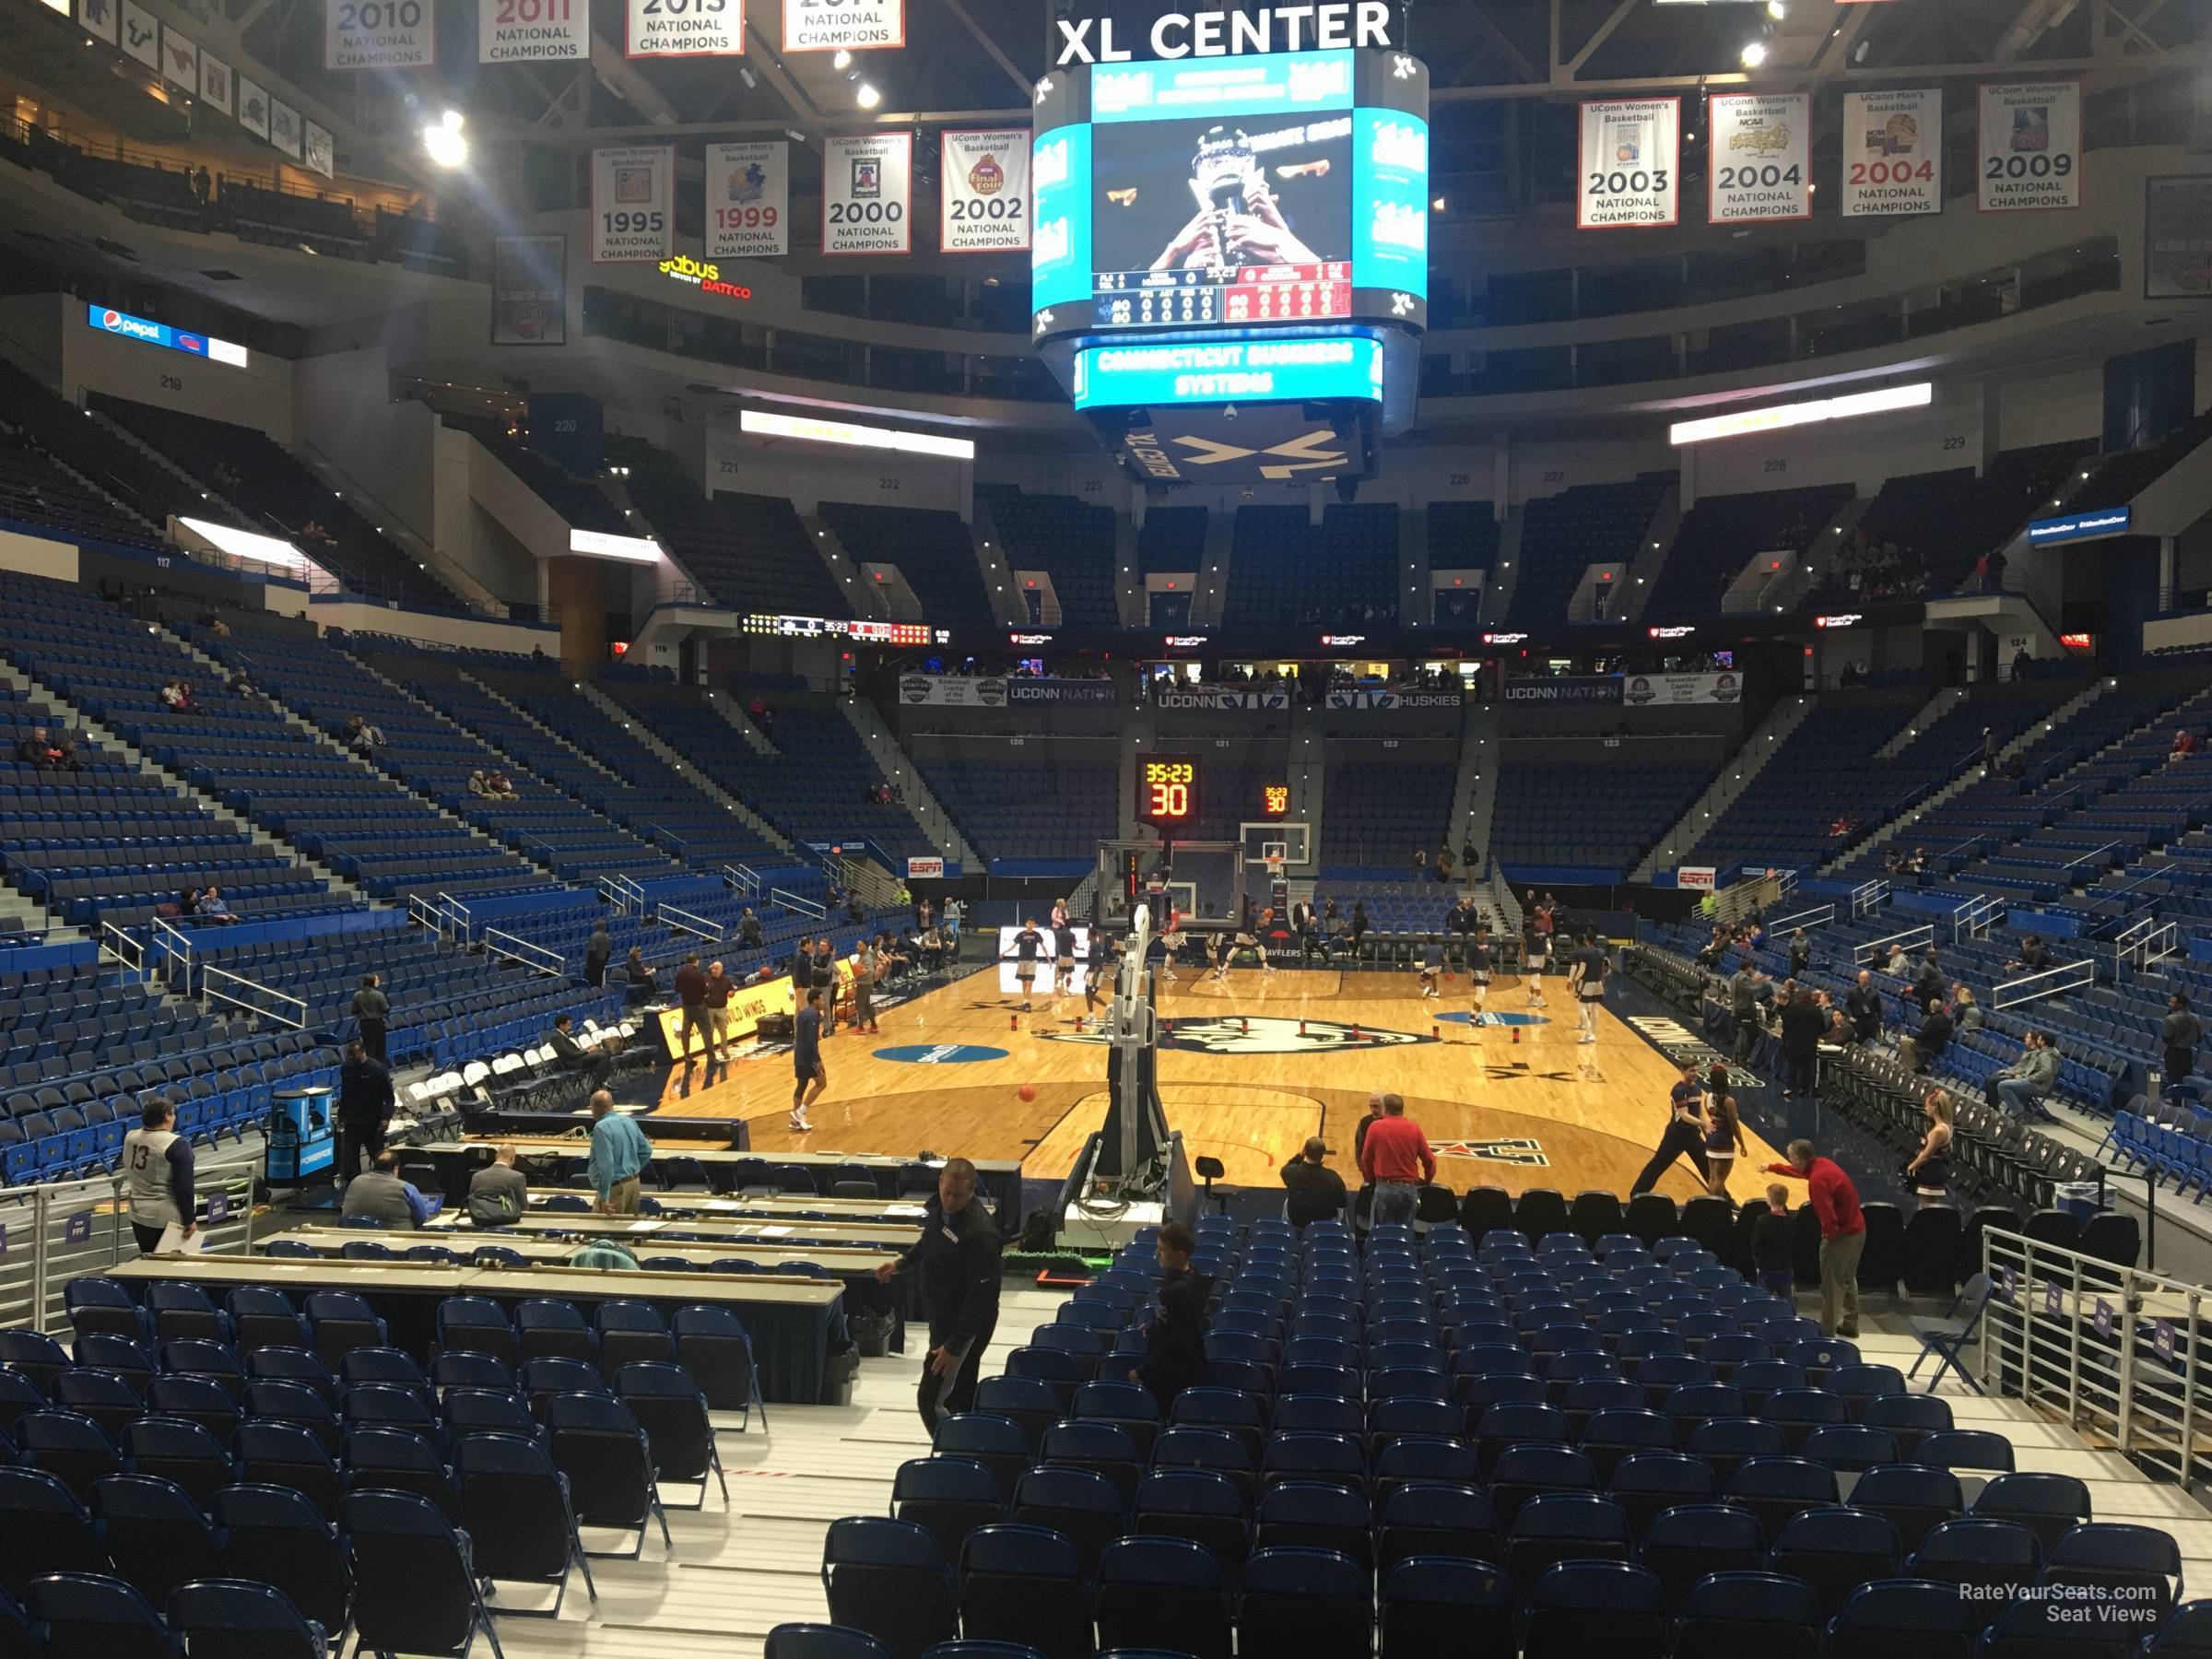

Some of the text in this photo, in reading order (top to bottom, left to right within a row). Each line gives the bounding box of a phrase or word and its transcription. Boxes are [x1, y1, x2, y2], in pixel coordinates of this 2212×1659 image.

[337, 2, 421, 30] 2010
[496, 0, 570, 24] 2011
[646, 18, 722, 32] NATIONAL
[805, 13, 882, 26] NATIONAL
[496, 27, 571, 41] NATIONAL
[798, 29, 888, 44] CHAMPIONS
[1056, 2, 1391, 65] XL CENTER
[343, 34, 416, 48] NATIONAL
[640, 37, 728, 51] CHAMPIONS
[490, 43, 578, 59] CHAMPIONS
[337, 51, 422, 65] CHAMPIONS
[1721, 96, 1801, 106] UConn Women's
[1861, 92, 1924, 101] UConn Men's
[2004, 96, 2055, 105] Basketball
[1591, 102, 1668, 112] UConn Women's
[1735, 107, 1786, 117] Basketball
[1866, 102, 1918, 112] Basketball
[1605, 113, 1653, 123] Basketball
[832, 137, 901, 147] UConn Women's
[952, 134, 980, 142] UConn
[720, 143, 774, 152] UConn Men's
[844, 147, 888, 156] Basketball
[964, 144, 1009, 152] Basketball
[725, 153, 769, 162] Basketball
[1849, 160, 1934, 184] 2004
[1986, 154, 2071, 179] 2009
[970, 173, 998, 184] Final
[1588, 170, 1667, 194] 2003
[1718, 164, 1802, 189] 2004
[1858, 187, 1924, 198] NATIONAL
[1994, 182, 2063, 193] NATIONAL
[1596, 197, 1659, 208] NATIONAL
[1727, 192, 1793, 203] NATIONAL
[1989, 195, 2068, 207] CHAMPIONS
[830, 201, 902, 223] 2000
[950, 197, 1022, 220] 2002
[1722, 206, 1798, 218] CHAMPIONS
[1853, 201, 1930, 213] CHAMPIONS
[603, 212, 664, 232] 1995
[715, 206, 777, 229] 1999
[1591, 211, 1665, 222] CHAMPIONS
[838, 227, 894, 237] NATIONAL
[957, 224, 1015, 233] NATIONAL
[606, 237, 661, 245] NATIONAL
[719, 232, 774, 242] NATIONAL
[952, 236, 1019, 246] CHAMPIONS
[714, 244, 780, 255] CHAMPIONS
[832, 240, 899, 250] CHAMPIONS
[601, 249, 665, 259] CHAMPIONS
[1186, 272, 1196, 284] 0
[701, 279, 752, 300] DATTCO
[123, 320, 159, 339] pepsi
[1098, 345, 1243, 371] CONNECTICUT
[160, 374, 182, 391] 219
[555, 420, 576, 432] 220
[1943, 437, 1965, 450] 229
[721, 462, 738, 474] 221
[1765, 459, 1786, 472] 228
[1451, 474, 1469, 485] 226
[1544, 471, 1564, 482] 227
[880, 478, 900, 490] 222
[1085, 481, 1103, 490] 223
[157, 557, 171, 567] 117
[825, 621, 848, 633] 35:23
[1011, 688, 1060, 700] UCONN
[1506, 687, 1557, 700] UCONN
[1158, 695, 1217, 708] UCONN
[1399, 695, 1460, 707] HUSKIES
[1604, 739, 1619, 747] 123
[1147, 764, 1192, 782] 35:23
[1265, 787, 1287, 797] 35:23
[1152, 784, 1187, 816] 30
[1268, 796, 1285, 812] 30
[910, 862, 942, 873] ESPN
[1679, 872, 1713, 884] ESPN
[745, 999, 767, 1018] WINGS
[1628, 1017, 1709, 1047] UCONN
[131, 1144, 147, 1171] 13
[300, 1147, 333, 1166] POWERADE
[213, 1206, 223, 1216] DDD
[72, 1228, 84, 1237] FFF
[2049, 1298, 2058, 1309] EEE
[2098, 1315, 2107, 1327] FFF
